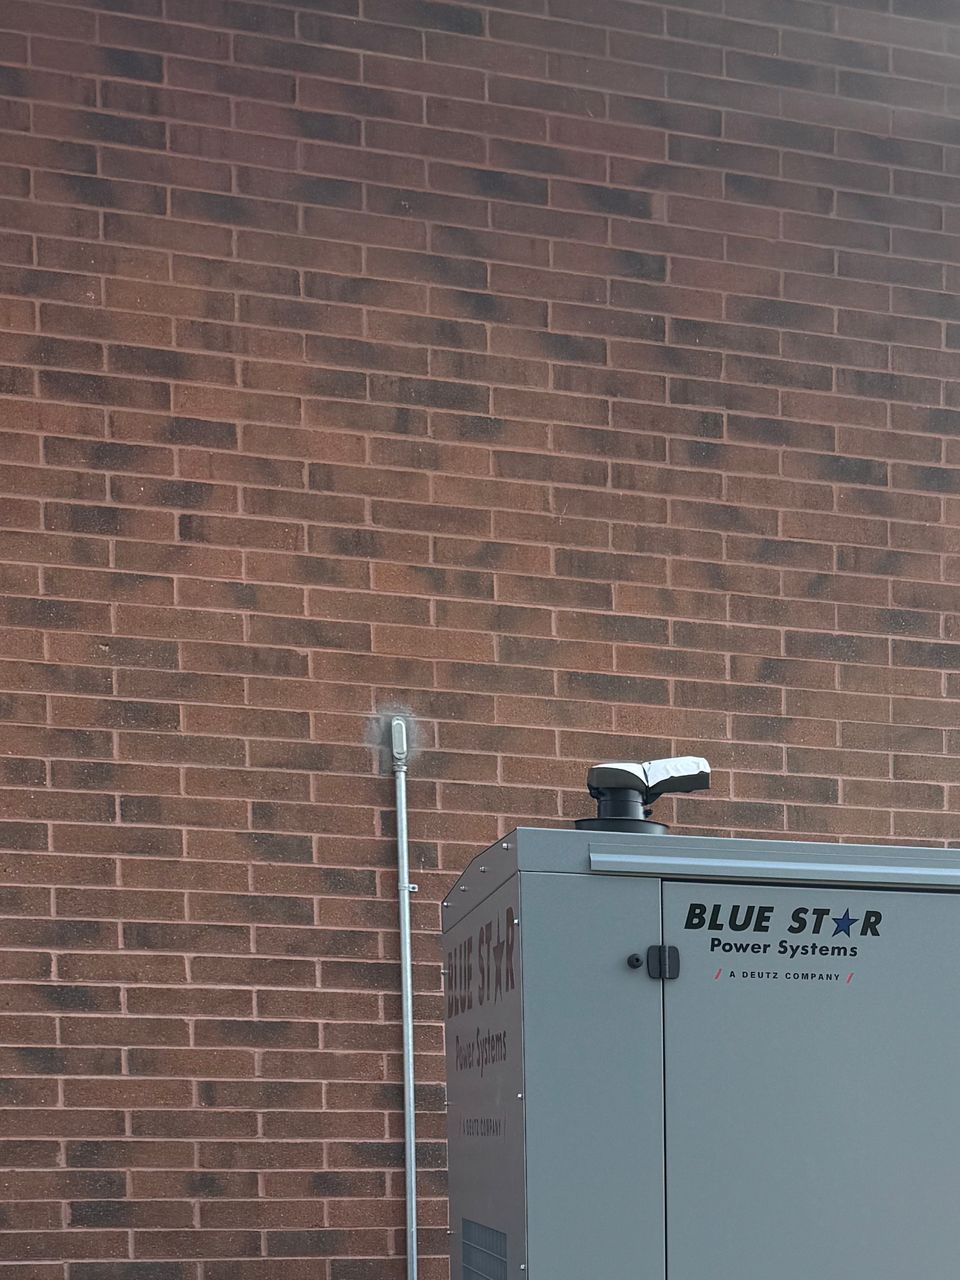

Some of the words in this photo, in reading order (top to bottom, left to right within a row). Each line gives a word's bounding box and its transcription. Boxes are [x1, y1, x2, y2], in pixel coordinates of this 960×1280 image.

[684, 903, 775, 933] BLUE
[710, 937, 771, 954] Power
[777, 940, 858, 959] Systems
[447, 936, 473, 1019] BLUE
[729, 971, 736, 979] A
[742, 971, 779, 980] DEUTZ
[785, 972, 840, 982] COMPANY
[455, 1035, 475, 1072] Power
[476, 1027, 507, 1078] Systems
